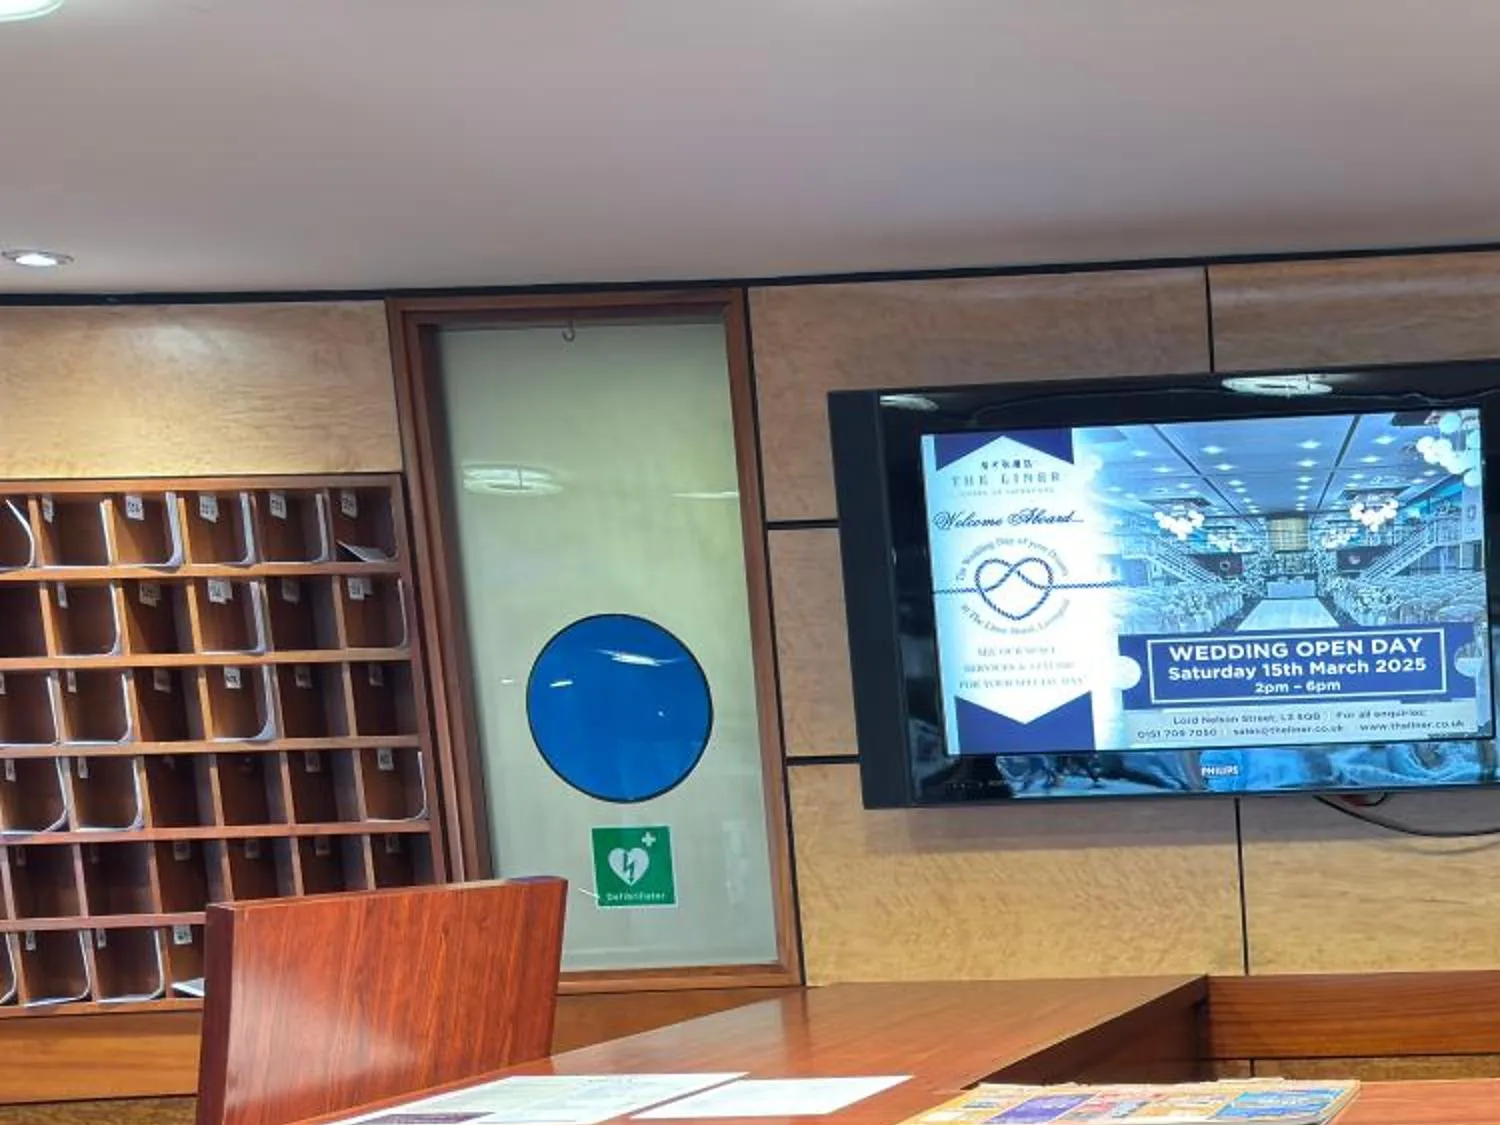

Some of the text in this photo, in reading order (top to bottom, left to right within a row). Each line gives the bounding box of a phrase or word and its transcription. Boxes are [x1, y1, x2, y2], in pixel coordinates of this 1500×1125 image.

[951, 471, 1061, 488] THE LINER
[933, 511, 1003, 531] Welcome
[1168, 637, 1423, 662] WEDDING OPEN DAY
[1168, 657, 1427, 681] Saturday 15th March 2025
[1254, 682, 1289, 694] 2pm
[1305, 680, 1341, 693] 6pm
[1172, 715, 1199, 726] Lord
[1201, 714, 1239, 725] Nelson
[1200, 765, 1239, 776] PHILIPS
